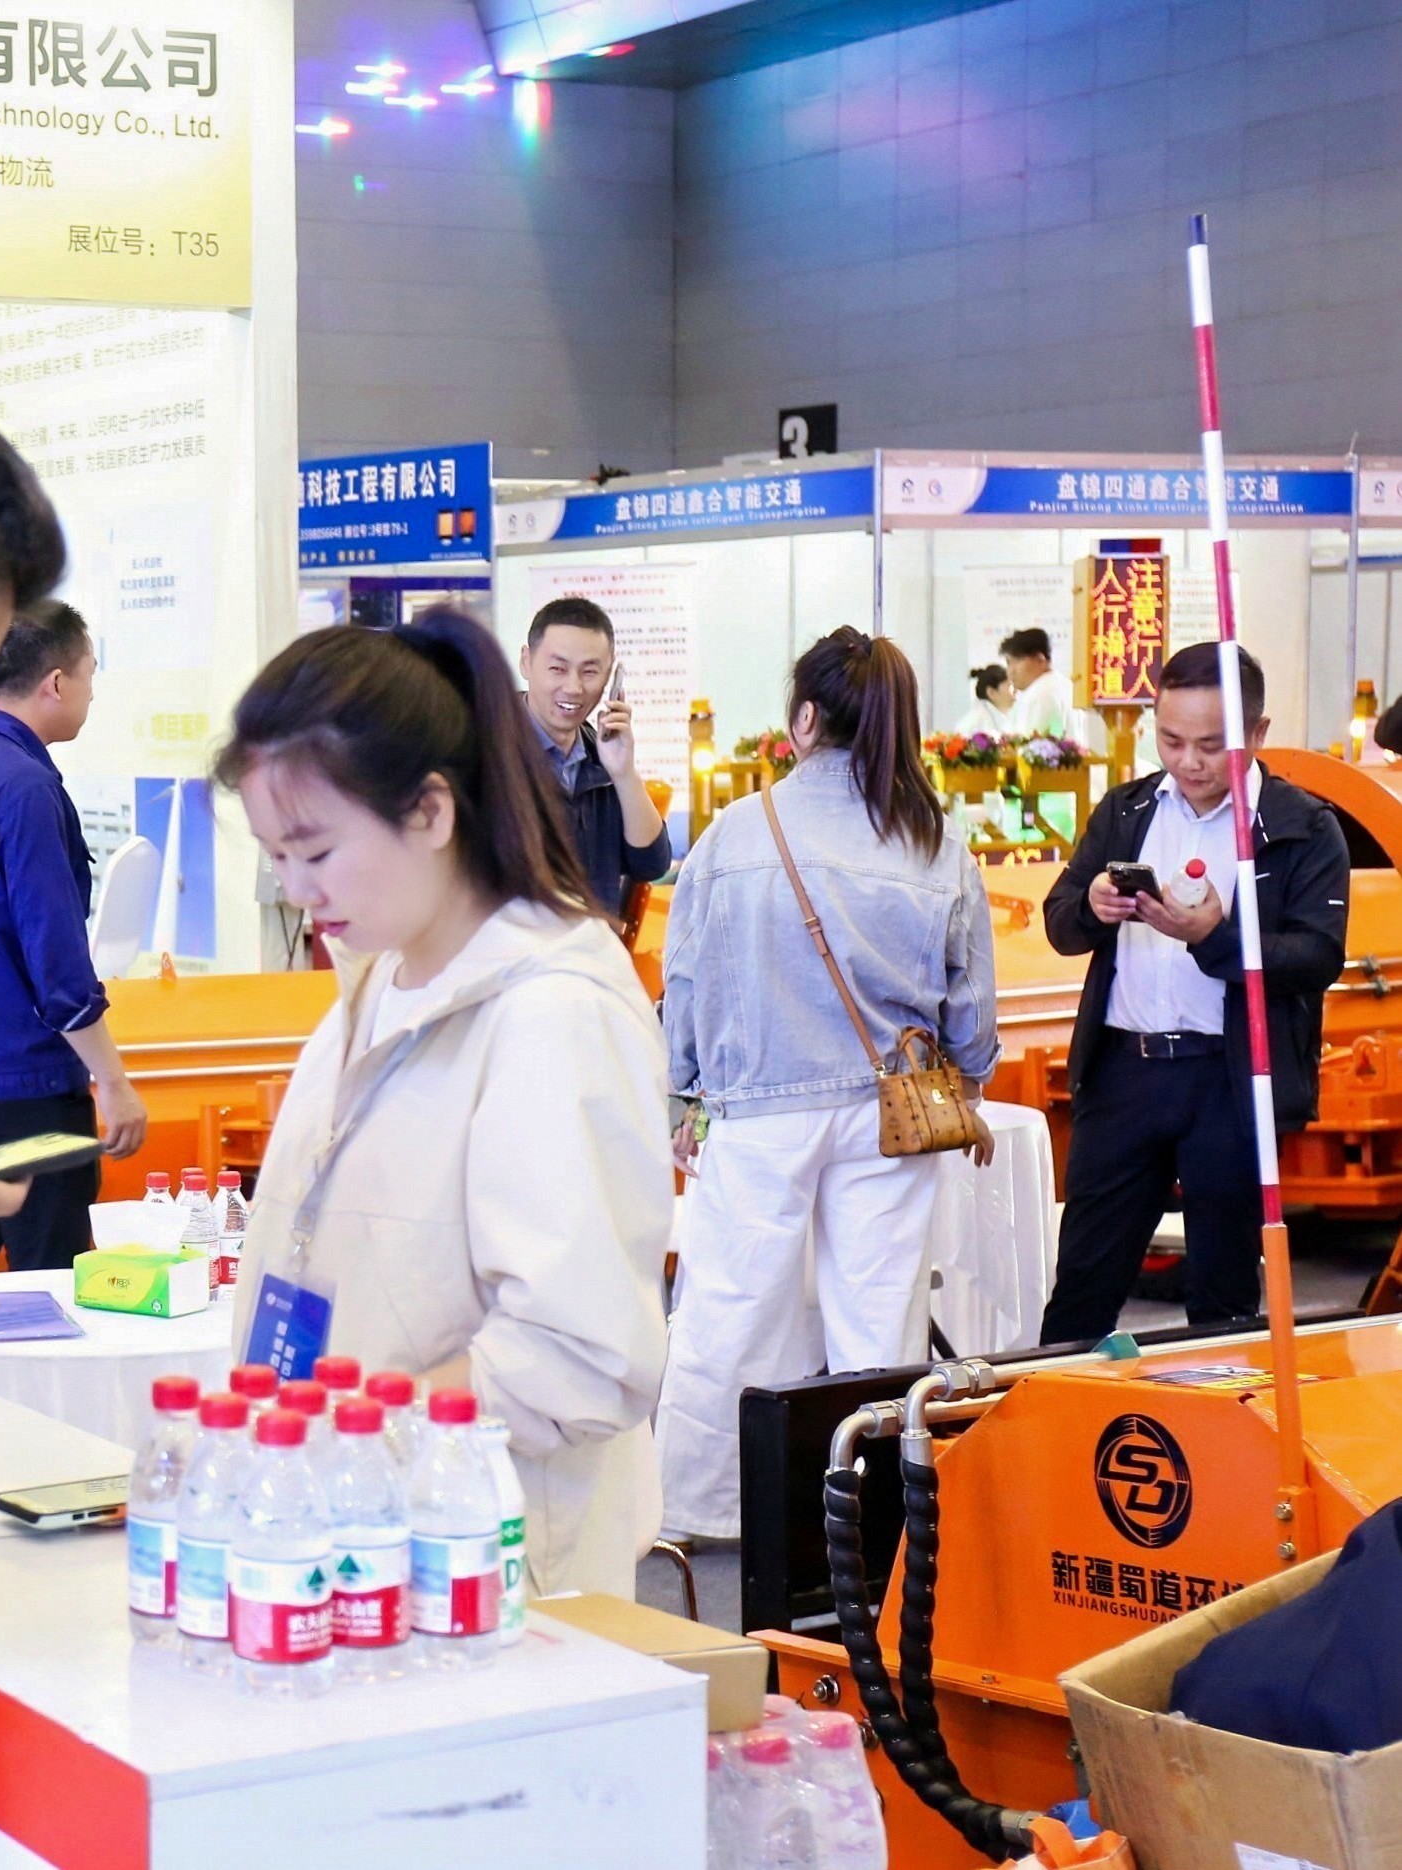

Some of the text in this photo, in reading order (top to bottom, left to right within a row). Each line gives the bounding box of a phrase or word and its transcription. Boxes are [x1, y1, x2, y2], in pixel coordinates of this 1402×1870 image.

[114, 110, 165, 139] Co.,
[174, 114, 220, 139] Ltd.
[782, 414, 809, 458] 3
[614, 480, 803, 521] 盘锦四通鑫合智能交通
[748, 506, 827, 521] Transportation
[1091, 557, 1129, 699] 人行横道
[1126, 557, 1163, 700] 注意行人
